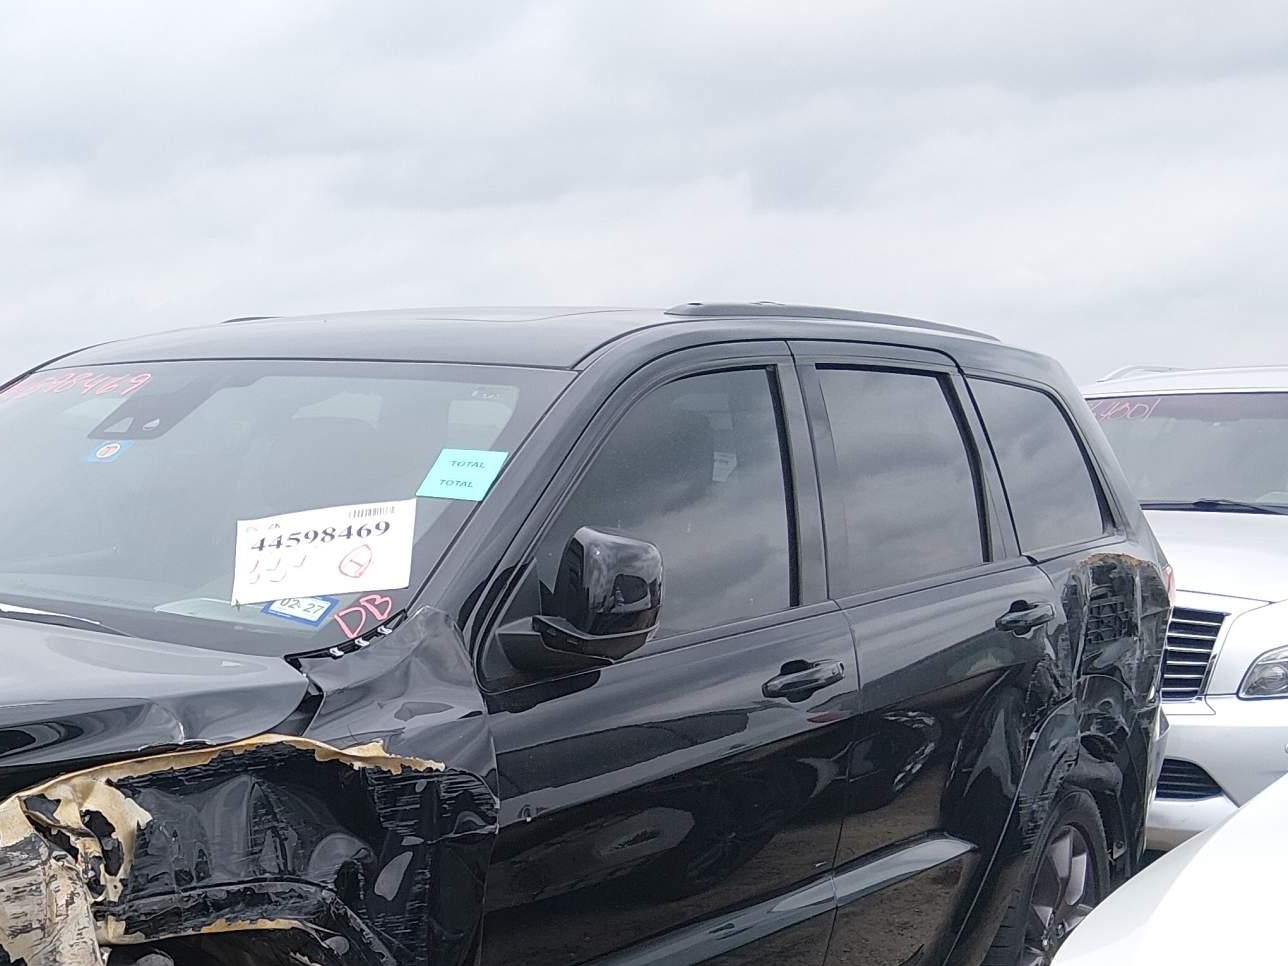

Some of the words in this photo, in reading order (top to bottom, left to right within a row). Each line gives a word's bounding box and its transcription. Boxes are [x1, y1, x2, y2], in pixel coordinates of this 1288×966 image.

[450, 459, 486, 469] TOTAL
[439, 478, 473, 488] TOTAL
[250, 520, 391, 552] 44598469
[333, 594, 392, 639] DB
